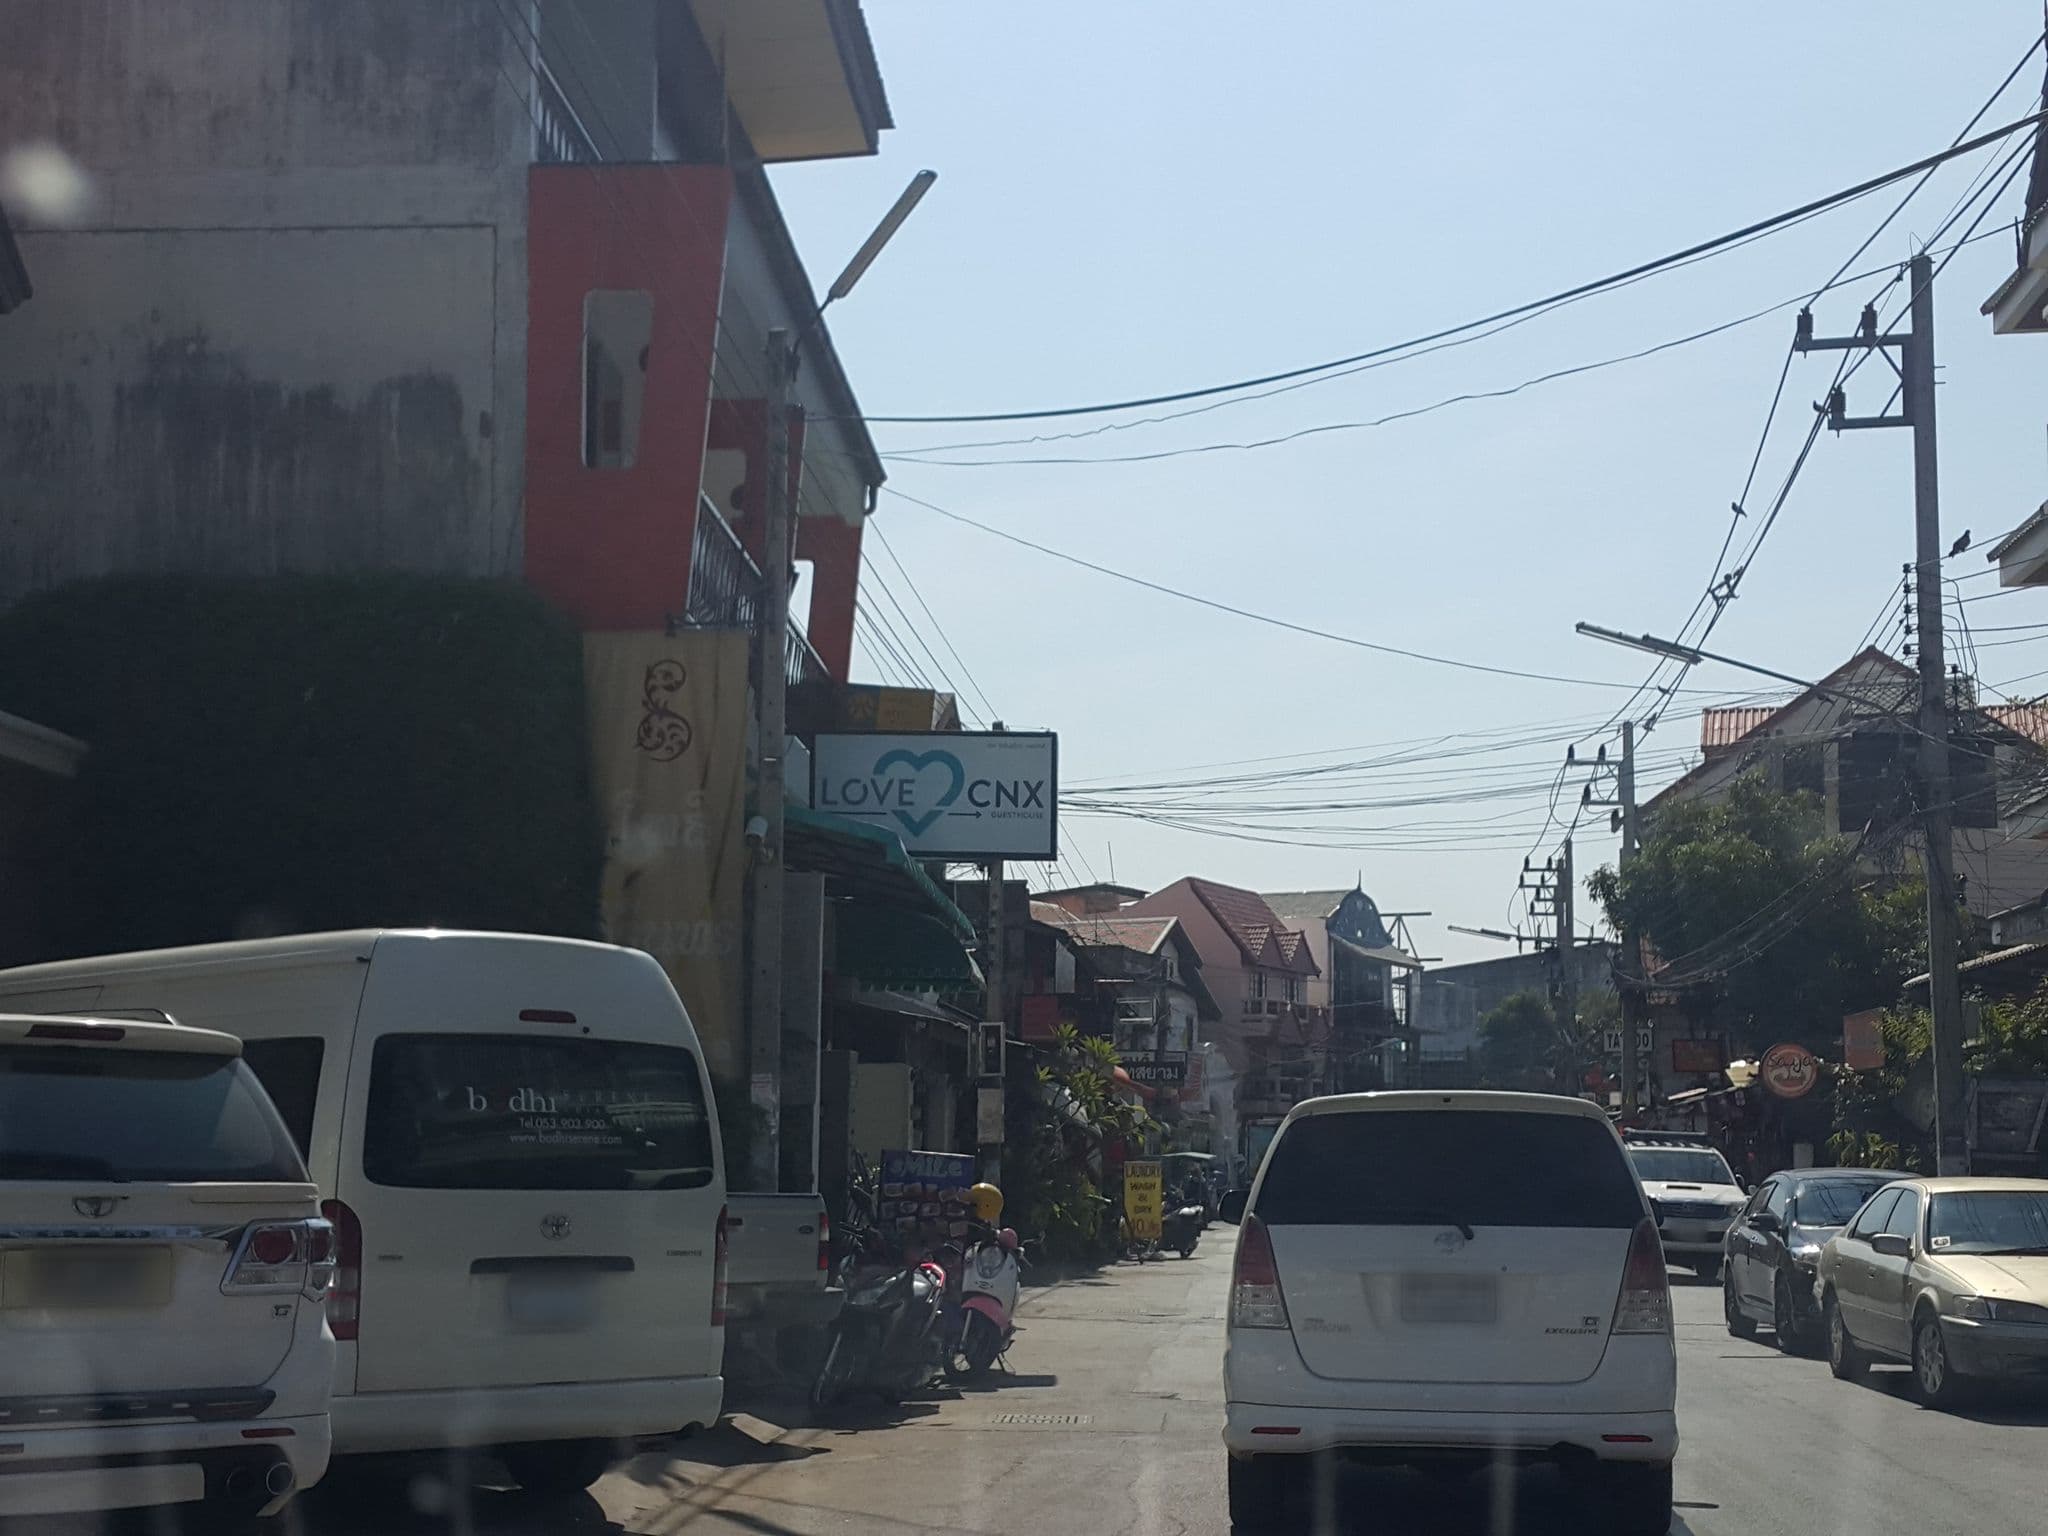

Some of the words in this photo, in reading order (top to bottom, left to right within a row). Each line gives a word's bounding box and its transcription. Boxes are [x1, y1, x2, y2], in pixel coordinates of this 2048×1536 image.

[822, 778, 915, 806] LOVE
[967, 779, 1044, 809] CNX
[991, 811, 1043, 819] GUESTHOUSE
